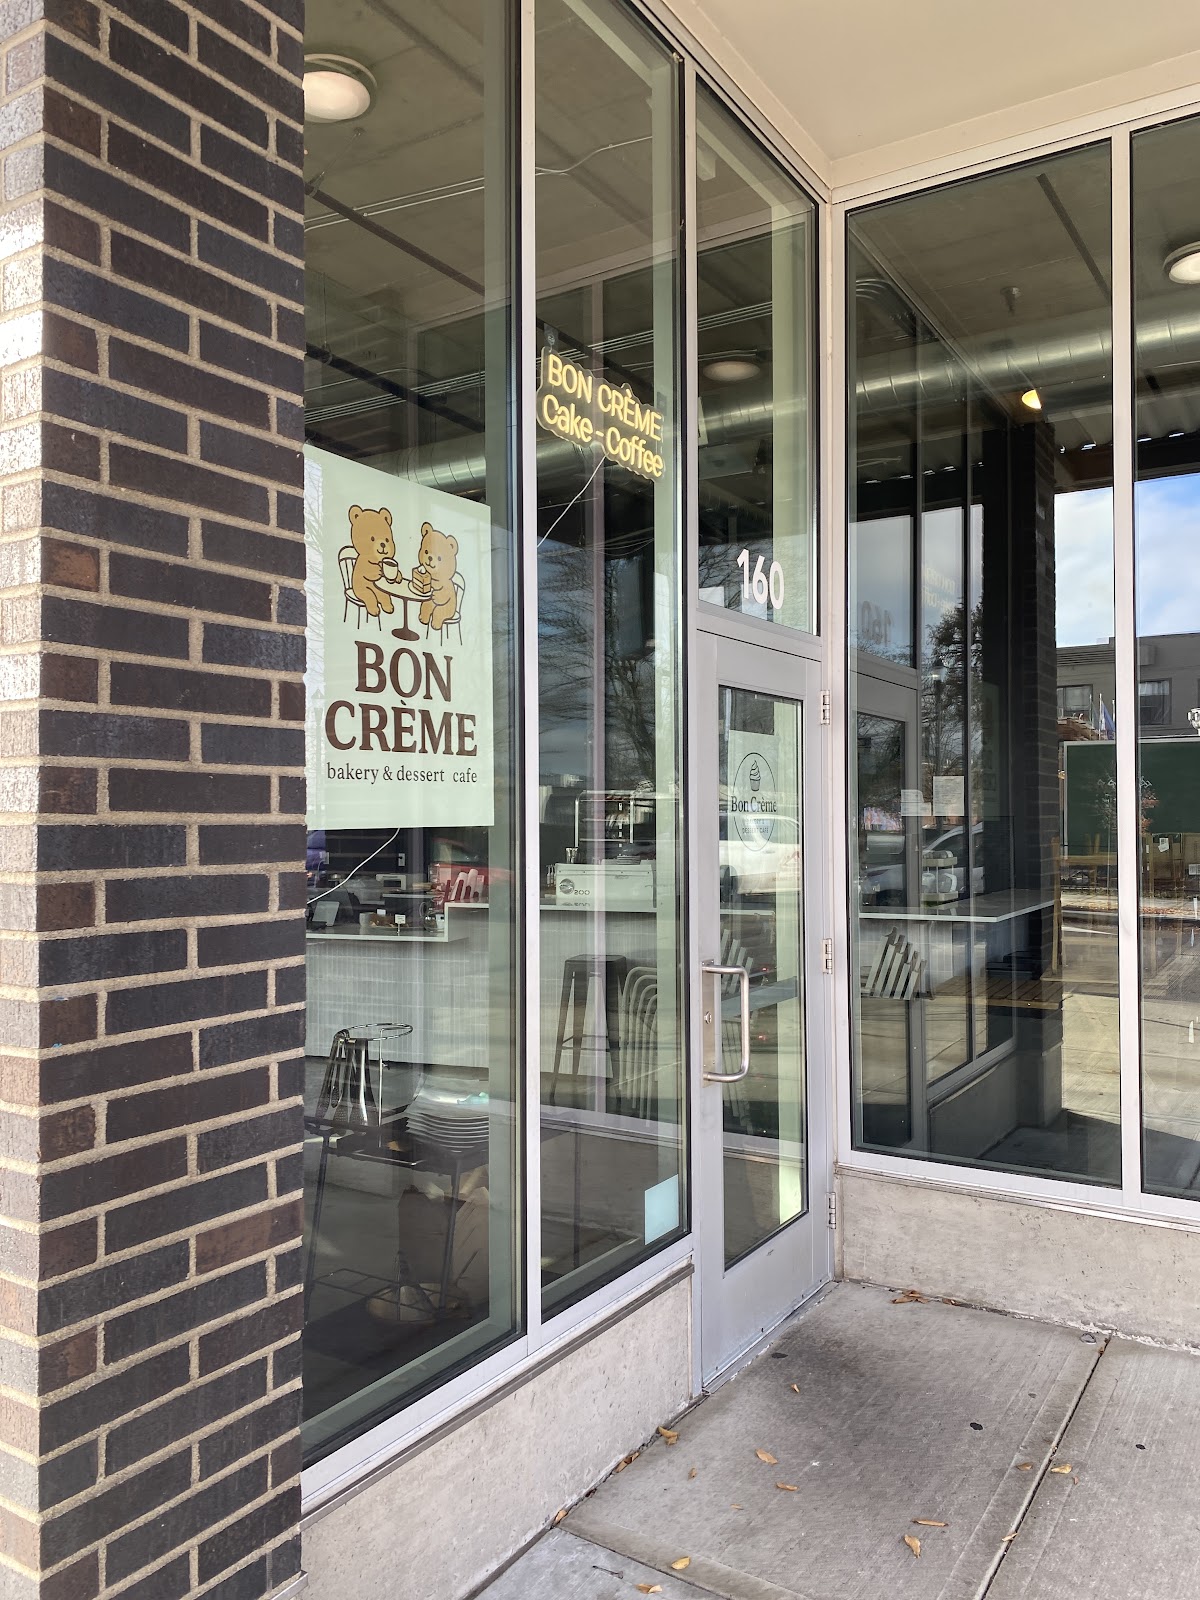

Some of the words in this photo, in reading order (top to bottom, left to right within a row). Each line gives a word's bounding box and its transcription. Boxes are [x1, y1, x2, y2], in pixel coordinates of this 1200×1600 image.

[548, 353, 593, 404] BON
[597, 383, 662, 442] CRÈME
[542, 394, 593, 443] Cake
[606, 426, 664, 478] Coffee
[736, 548, 785, 610] 160
[354, 640, 453, 702] BON
[325, 699, 478, 757] CRÈME
[326, 762, 379, 785] bakery
[382, 765, 393, 781] &
[396, 764, 445, 782] dessert
[452, 767, 478, 783] cafe
[730, 795, 749, 813] Bon
[750, 796, 777, 813] Crème
